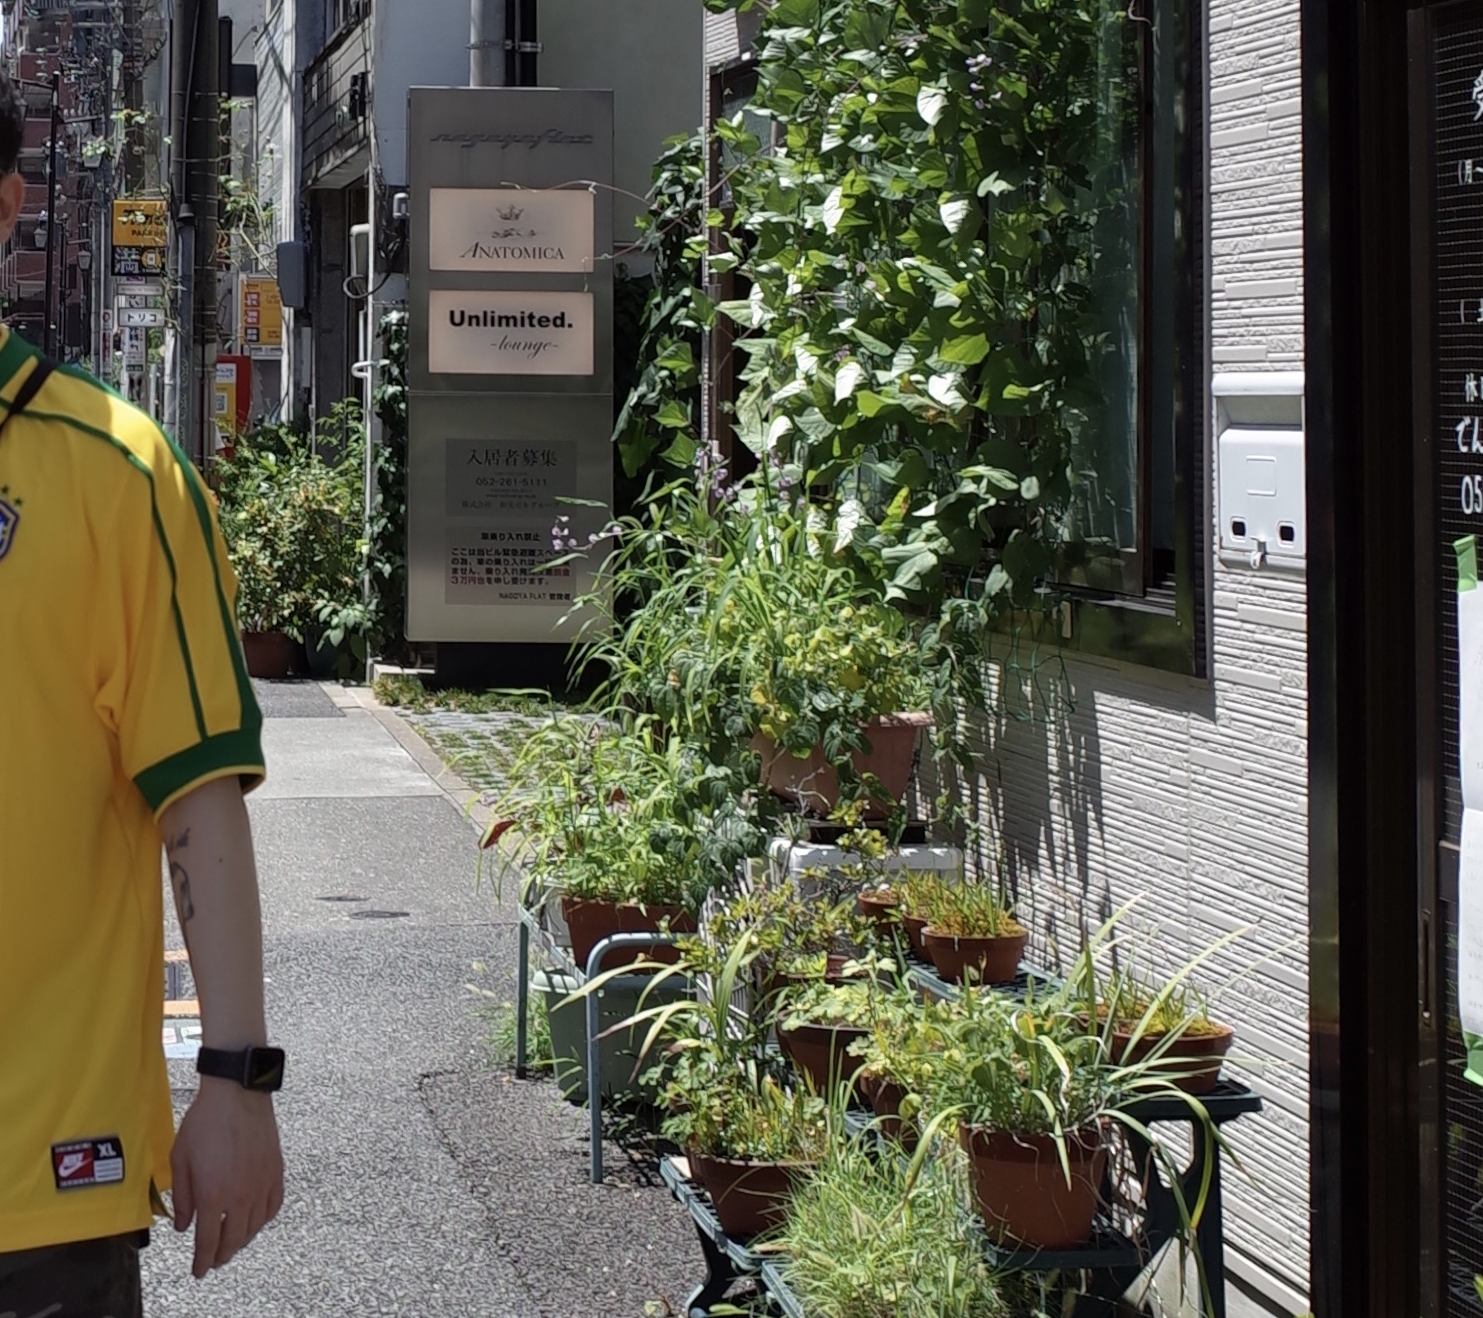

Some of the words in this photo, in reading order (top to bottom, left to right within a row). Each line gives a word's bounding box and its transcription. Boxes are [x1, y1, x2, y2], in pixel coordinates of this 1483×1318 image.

[459, 241, 565, 260] ANATOMICA
[126, 313, 158, 323] トリコ
[448, 309, 573, 329] Unlimited.
[467, 448, 558, 468] 入居者募集
[96, 1142, 117, 1158] XL
